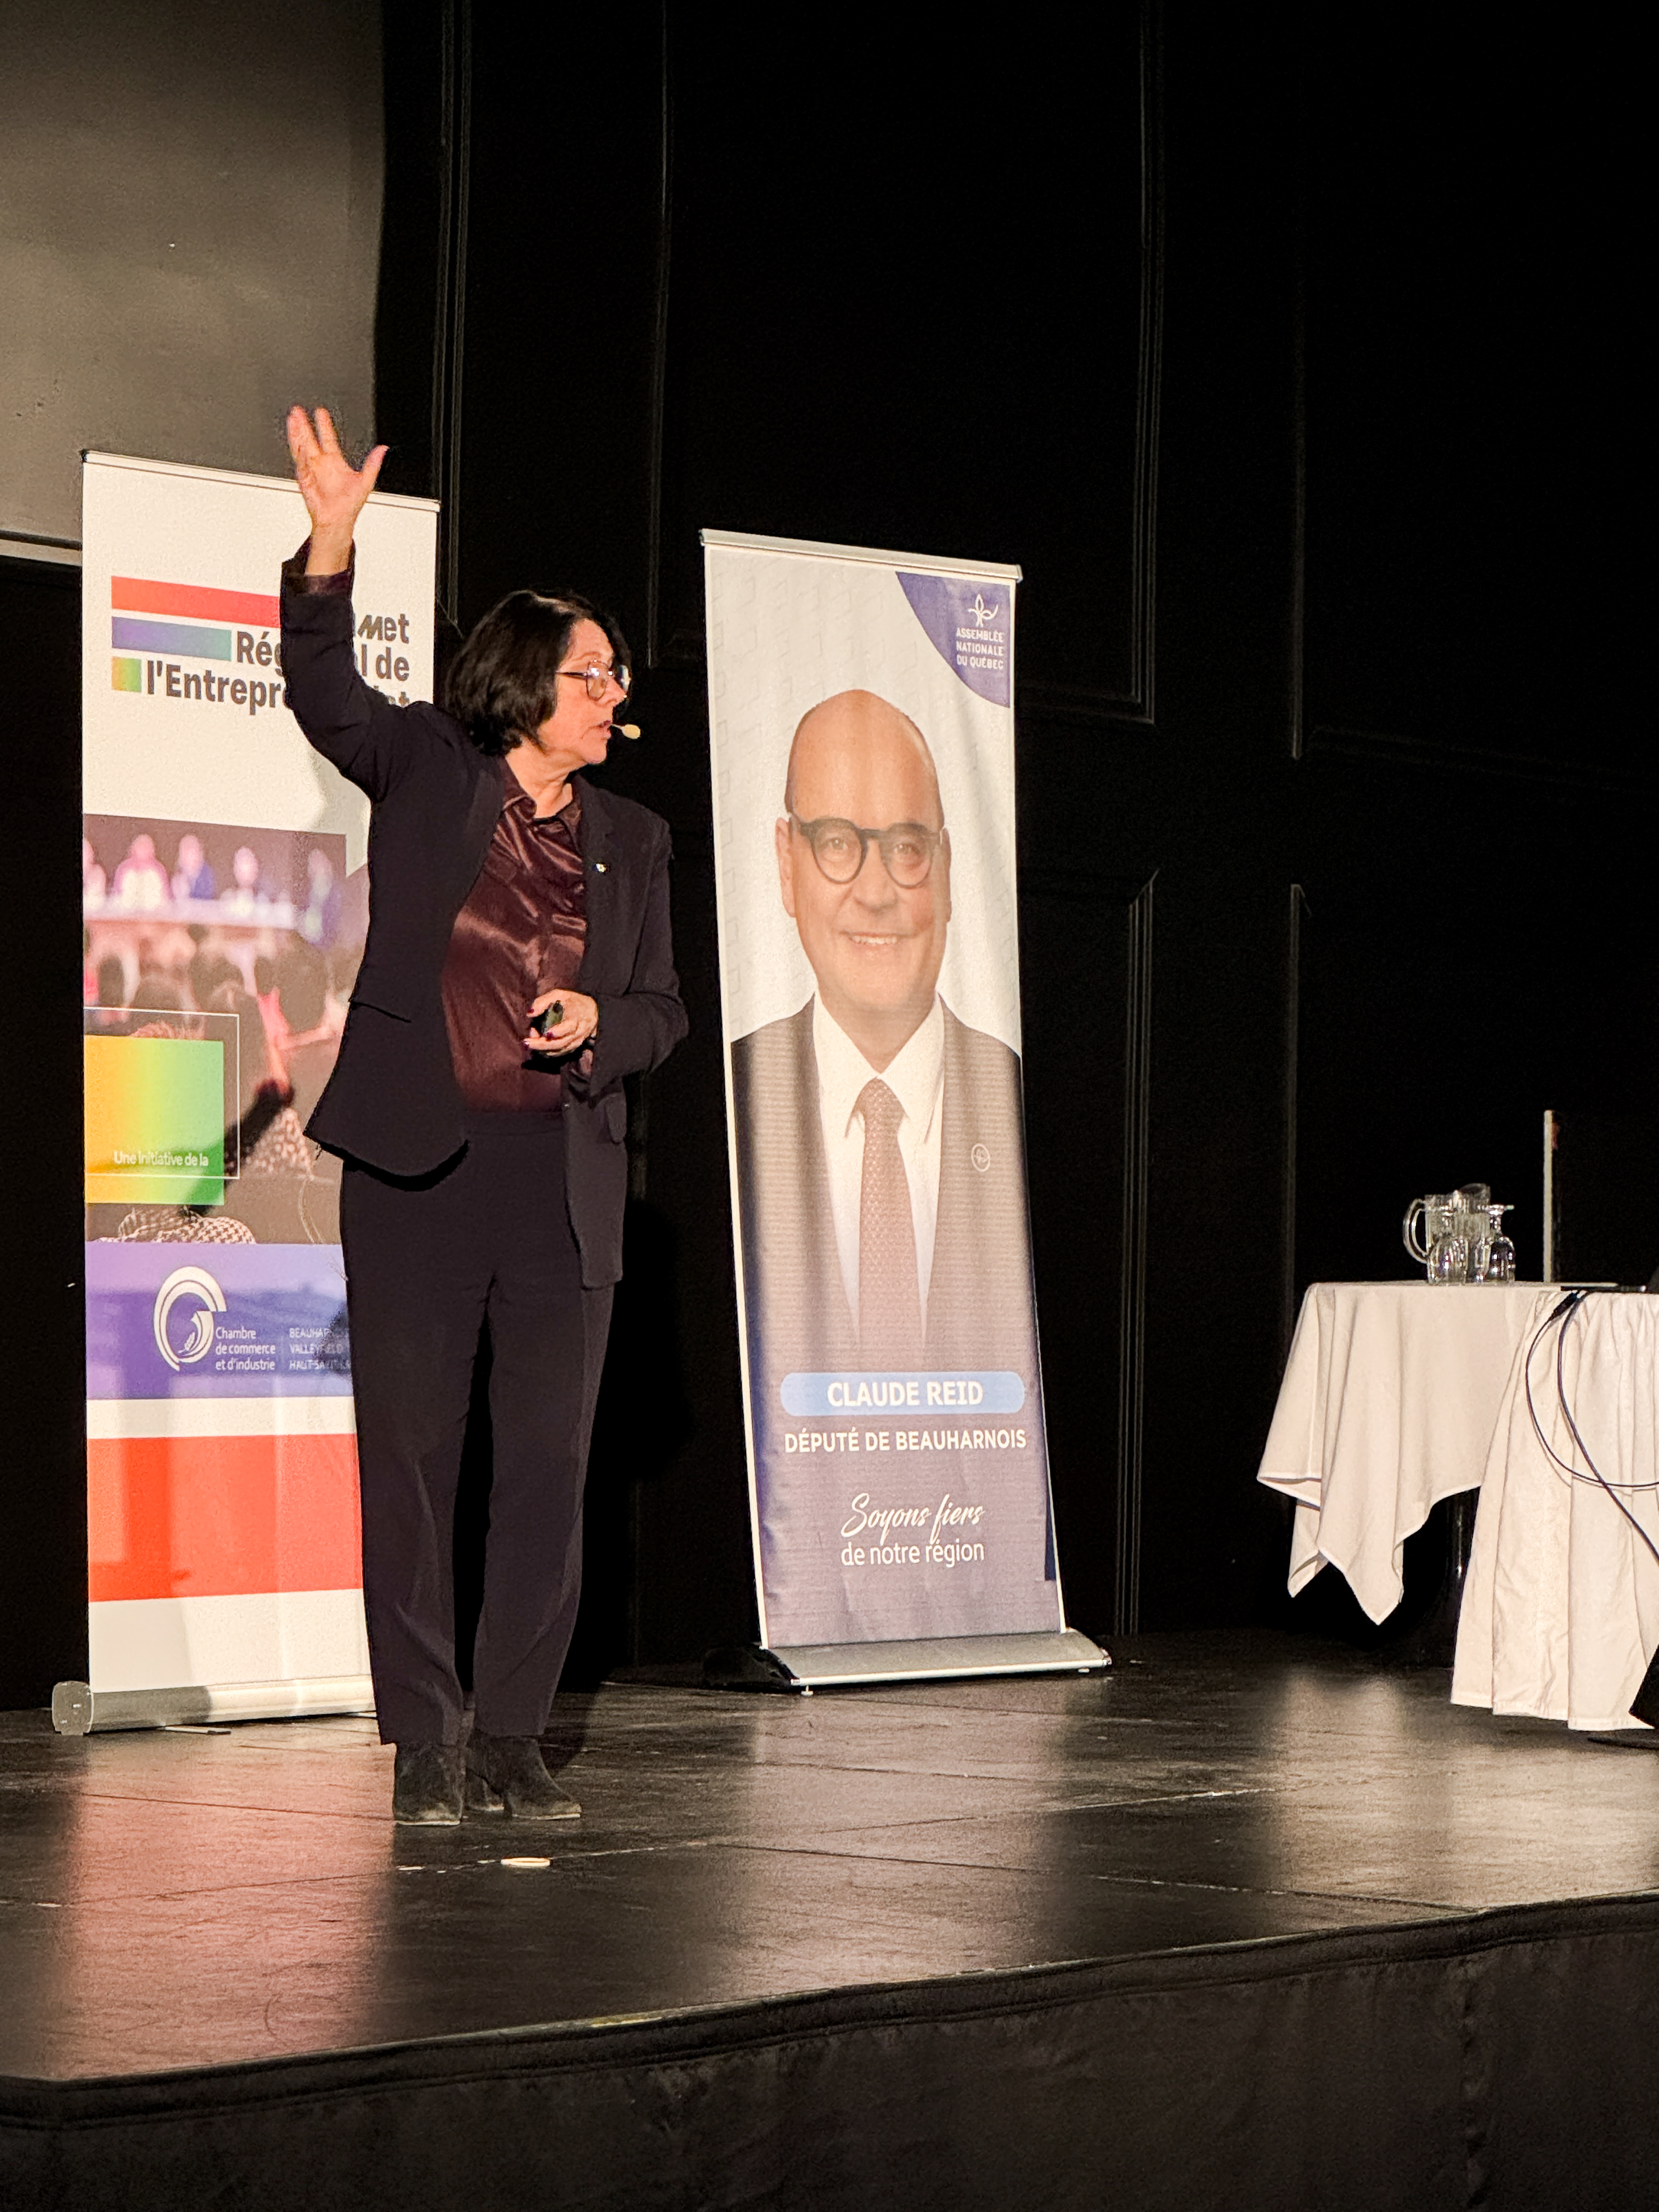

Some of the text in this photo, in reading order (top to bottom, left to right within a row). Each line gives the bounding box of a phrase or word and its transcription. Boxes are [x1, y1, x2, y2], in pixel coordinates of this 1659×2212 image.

[956, 627, 1004, 642] ASSEMBLÉE
[956, 641, 1004, 656] NATIONALE
[376, 646, 410, 681] de
[956, 654, 1004, 670] DU QUÉBEC
[114, 1150, 136, 1164] Une
[184, 1152, 198, 1166] de
[200, 1153, 209, 1167] la
[215, 1325, 256, 1339] Chambre
[215, 1344, 276, 1355] de commerce
[215, 1357, 275, 1370] et d'industrie
[827, 1380, 984, 1407] CLAUDE REID
[784, 1427, 1027, 1453] DÉPUTÉ DE BEAUHARNOIS
[840, 1492, 985, 1546] Soyons fiers
[841, 1538, 985, 1568] de notre région
